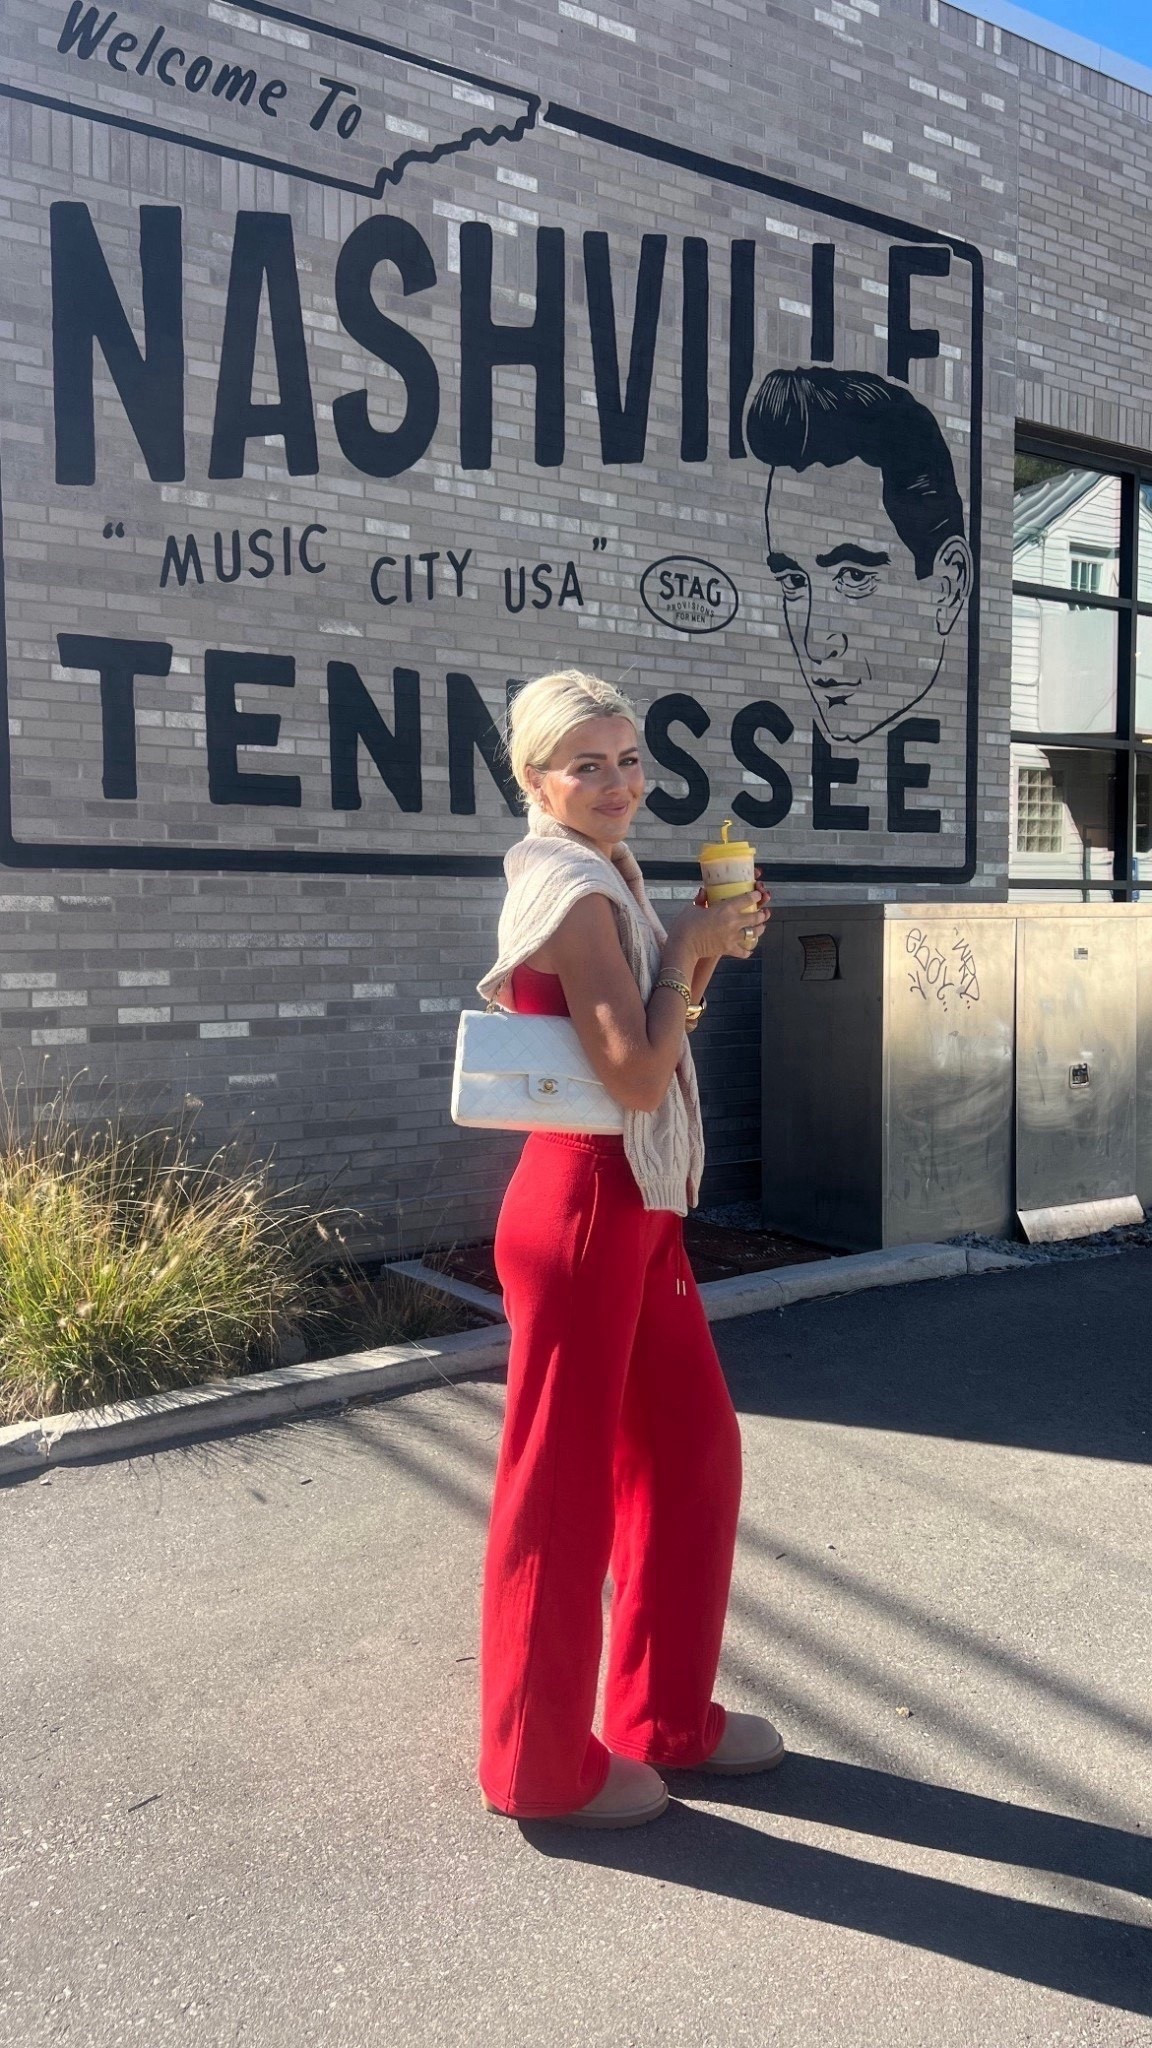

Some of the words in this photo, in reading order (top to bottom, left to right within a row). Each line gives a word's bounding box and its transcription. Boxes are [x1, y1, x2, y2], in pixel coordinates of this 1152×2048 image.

[57, 0, 287, 117] Welcome
[309, 77, 363, 139] To
[370, 548, 472, 605] CITY
[660, 570, 721, 607] STAG
[666, 601, 715, 617] PROVISIONS
[676, 612, 690, 621] FOR
[691, 615, 706, 623] MEN
[56, 632, 942, 835] TENNSSEE
